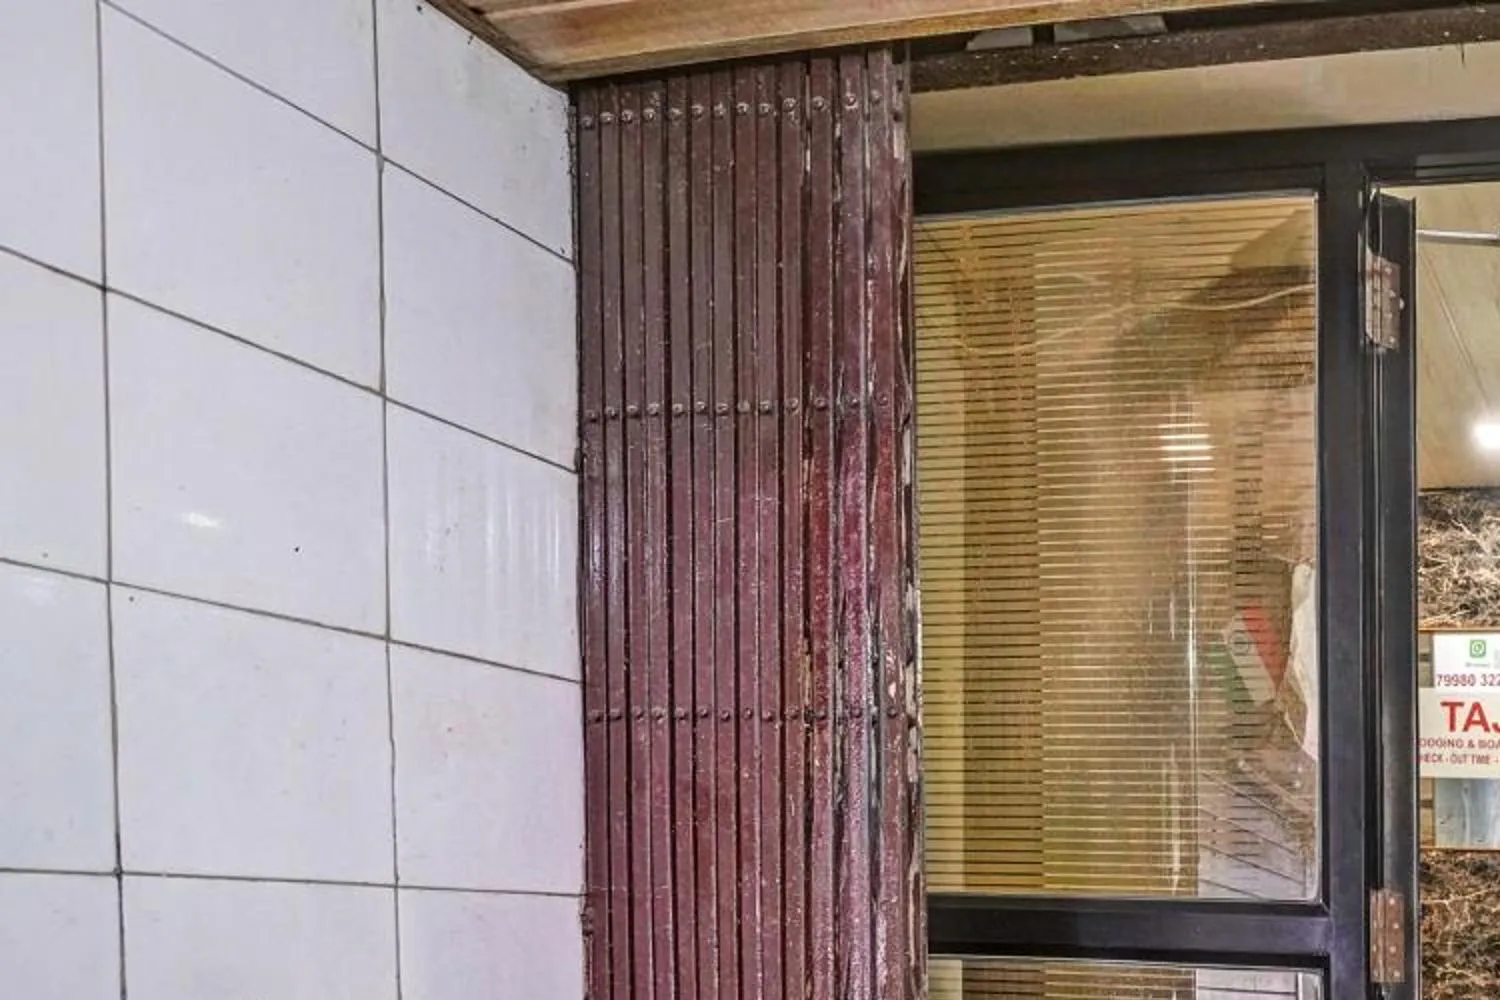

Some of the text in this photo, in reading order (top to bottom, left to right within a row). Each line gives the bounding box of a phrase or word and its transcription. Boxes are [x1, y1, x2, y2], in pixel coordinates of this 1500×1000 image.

[1437, 673, 1477, 687] 79980
[1419, 738, 1464, 749] ODGING
[1467, 739, 1475, 749] &
